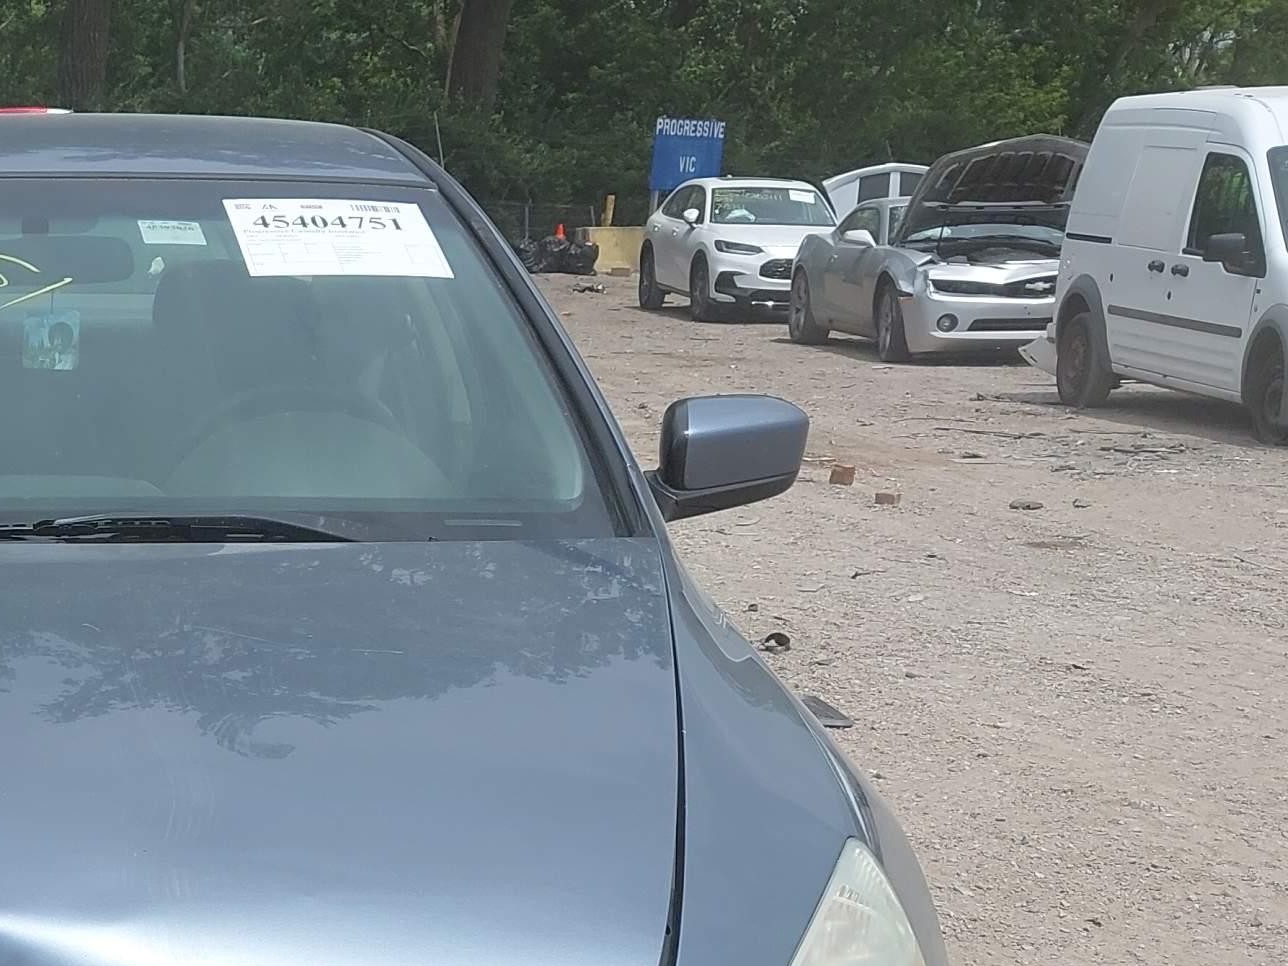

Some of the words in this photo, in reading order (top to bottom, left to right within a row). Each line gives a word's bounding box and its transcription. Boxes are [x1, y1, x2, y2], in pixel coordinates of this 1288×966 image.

[656, 117, 726, 139] PROGRESSIVE
[679, 156, 697, 173] VIC
[252, 214, 402, 230] 45404751
